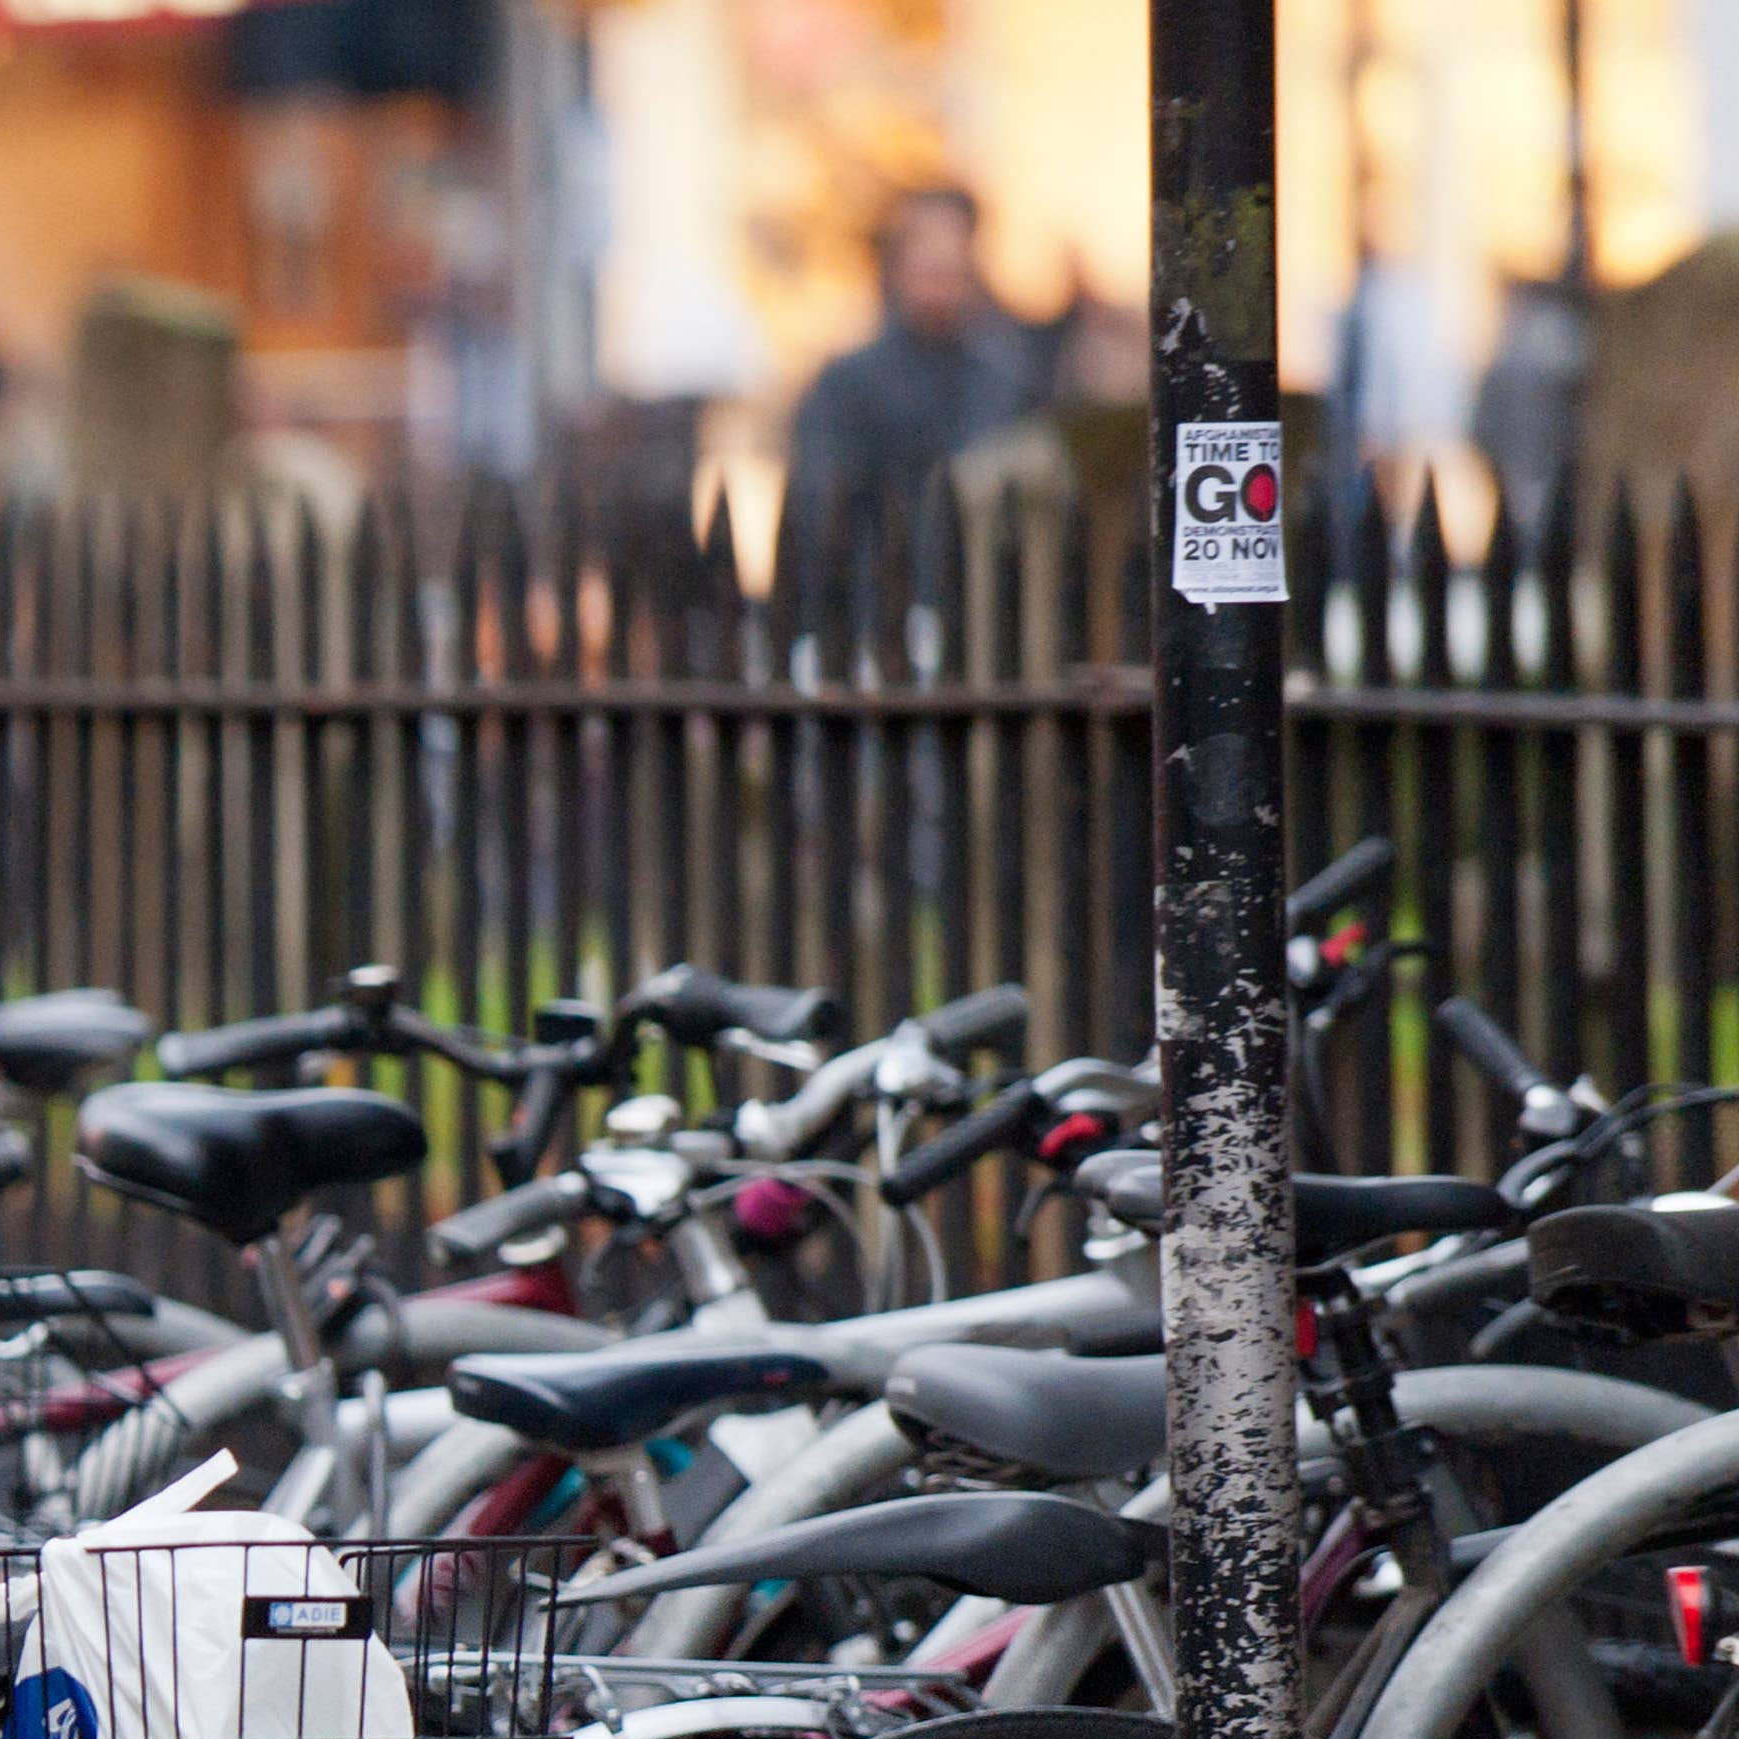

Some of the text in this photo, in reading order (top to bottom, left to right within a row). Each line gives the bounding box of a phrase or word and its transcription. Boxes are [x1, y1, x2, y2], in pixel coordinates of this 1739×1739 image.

[1185, 442, 1249, 462] TIME
[1185, 463, 1277, 523] GO
[1184, 539, 1220, 560] 20
[297, 1607, 341, 1622] ADIE
